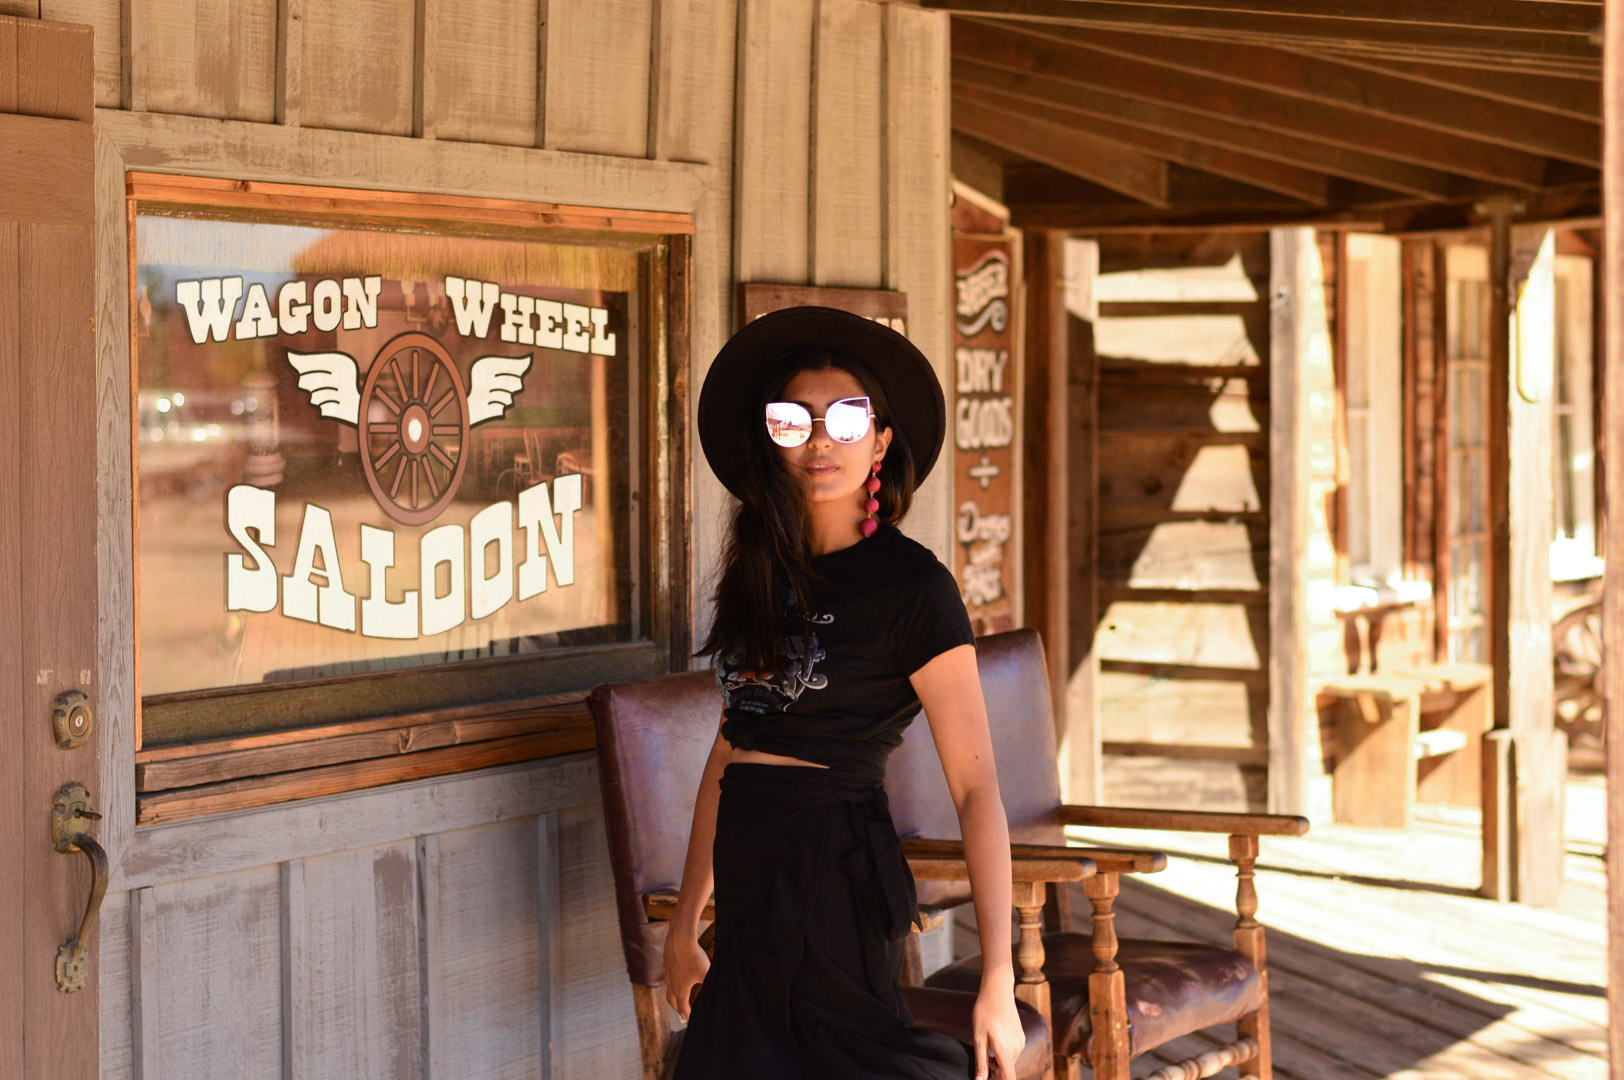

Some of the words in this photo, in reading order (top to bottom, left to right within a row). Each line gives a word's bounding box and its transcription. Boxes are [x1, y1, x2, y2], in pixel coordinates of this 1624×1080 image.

[956, 348, 1008, 393] DRY
[955, 396, 1013, 450] GOODS
[224, 472, 583, 640] SALOON
